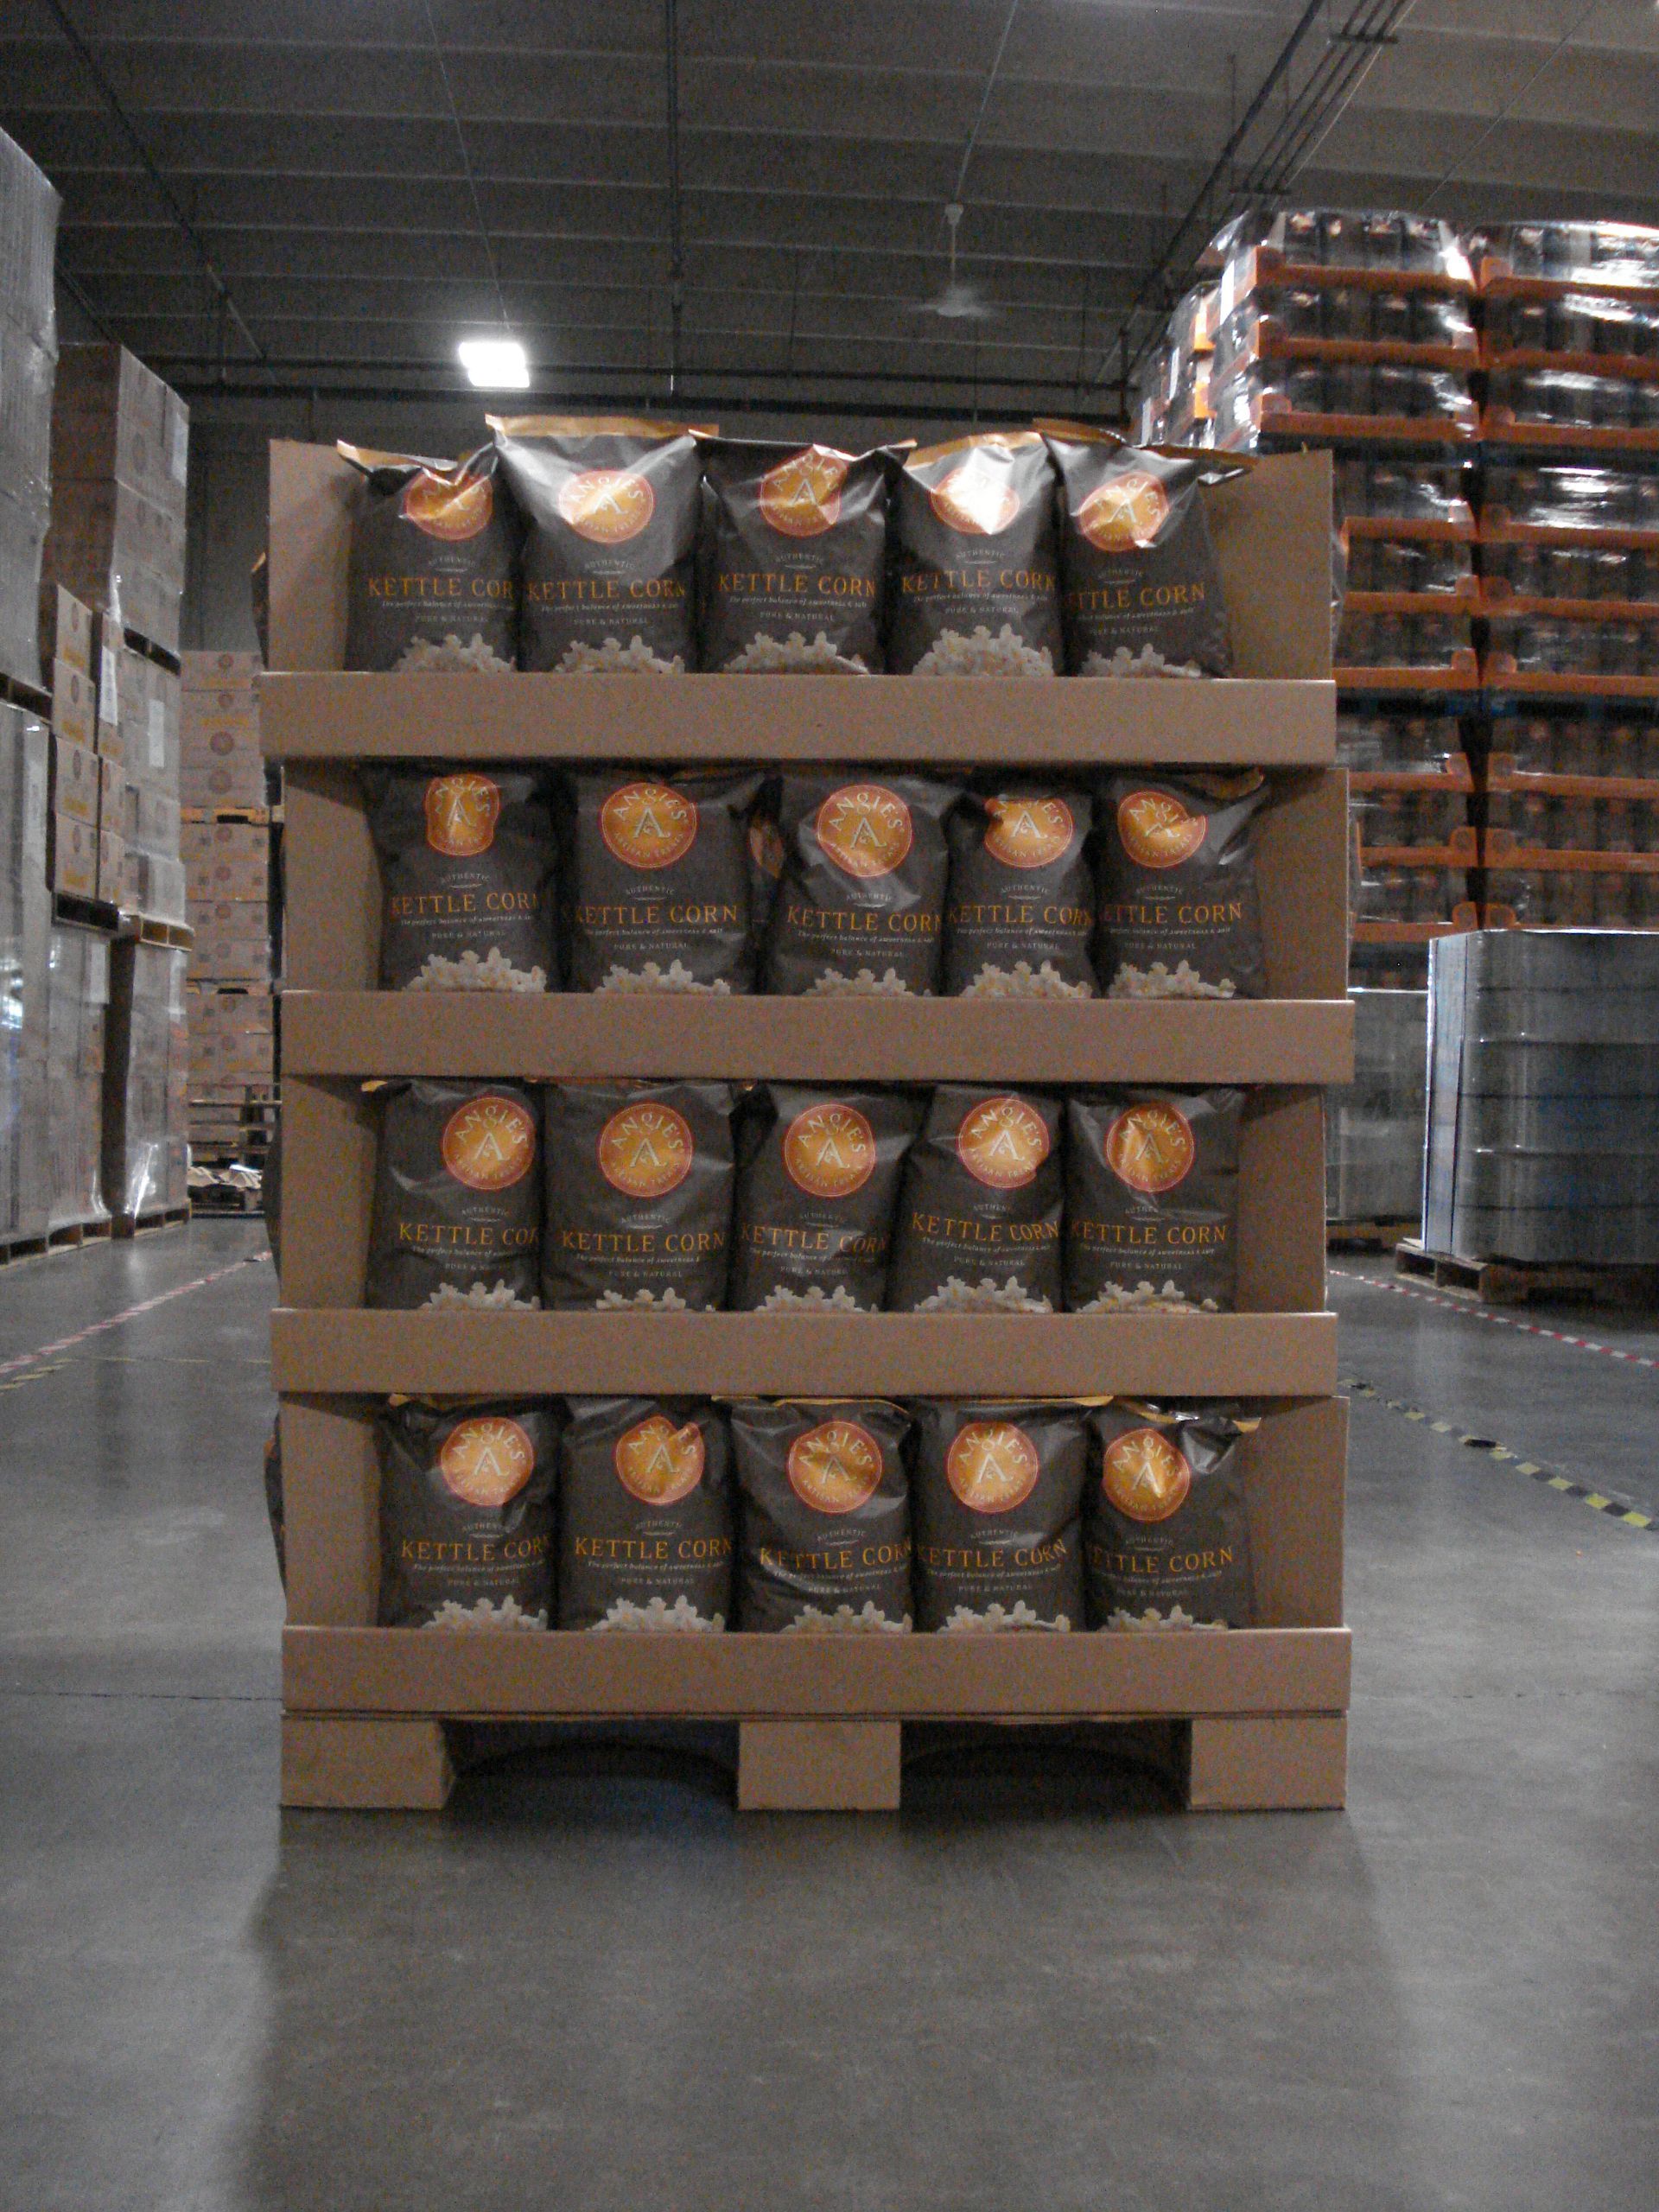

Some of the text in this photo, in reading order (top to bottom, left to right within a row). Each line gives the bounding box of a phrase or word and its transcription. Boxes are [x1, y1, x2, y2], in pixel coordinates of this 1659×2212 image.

[367, 575, 514, 599] KETTLE COR
[527, 580, 620, 601] KETTLE
[718, 572, 877, 598] KETTLE CORN
[901, 569, 1056, 594] KETTLE CORN
[1140, 582, 1205, 607] CORN
[1011, 810, 1048, 839] A
[626, 885, 676, 895] AUTHENTIC
[1001, 885, 1049, 893] AUTHENTIC
[670, 905, 737, 924] CORN
[787, 906, 880, 931] KETTLE
[1178, 902, 1243, 924] CORN
[474, 1132, 511, 1161] A
[630, 1137, 668, 1167] A
[816, 1137, 850, 1168] A
[988, 1129, 1026, 1162] A
[399, 1222, 493, 1245] KETTLE
[741, 1223, 830, 1251] KETTLE
[912, 1211, 1059, 1242] KETTLE CORN
[1167, 1225, 1228, 1244] CORN
[562, 1230, 724, 1252] KETTLE CORN
[474, 1446, 510, 1477] A
[646, 1443, 679, 1474] A
[976, 1453, 1014, 1484] A
[402, 1539, 495, 1561] KETTLE
[575, 1536, 732, 1560] KETTLE CORN
[1014, 1539, 1068, 1567] CORN
[1169, 1546, 1233, 1572] CORN
